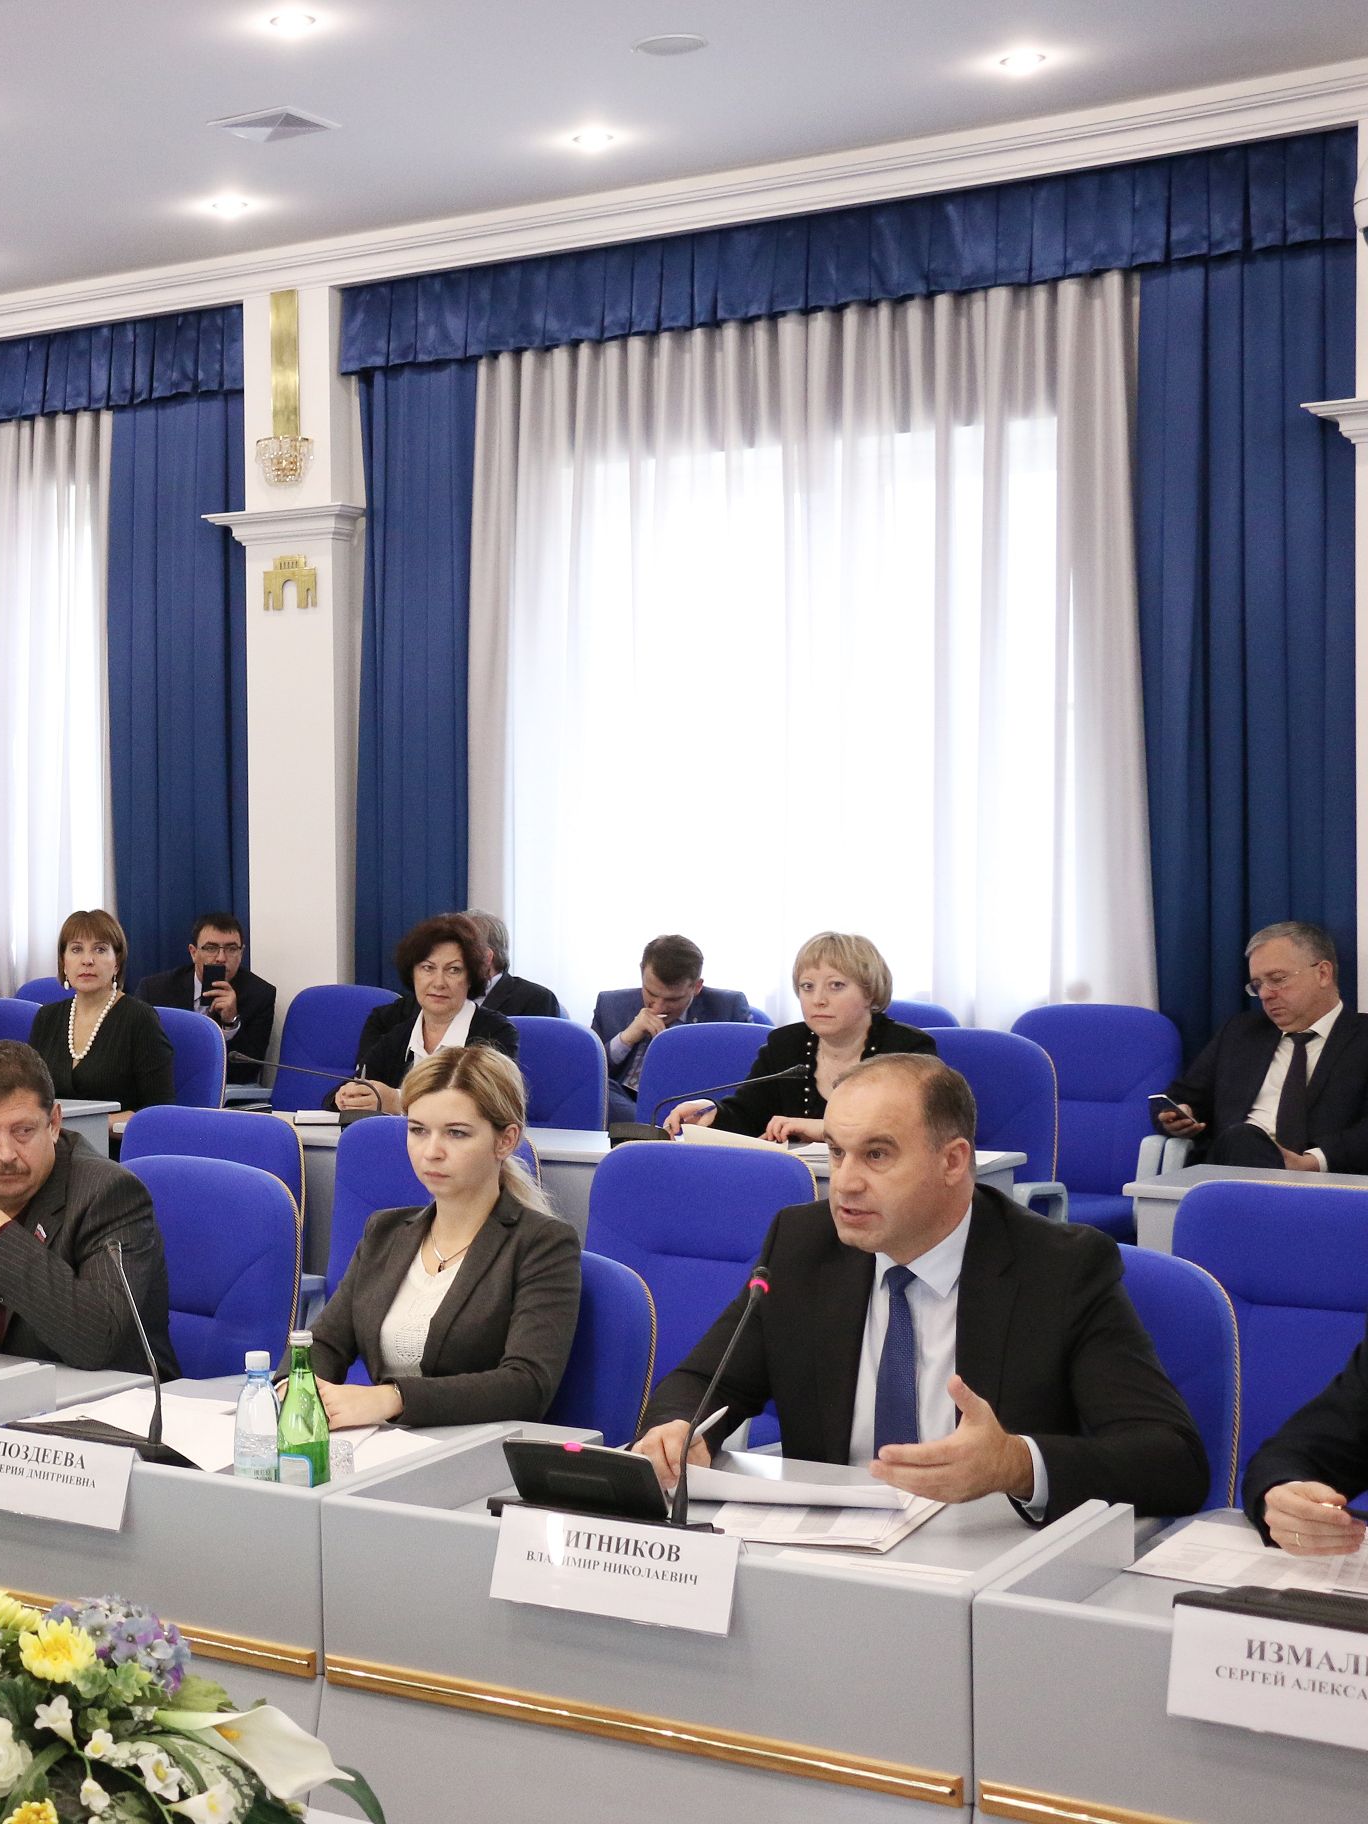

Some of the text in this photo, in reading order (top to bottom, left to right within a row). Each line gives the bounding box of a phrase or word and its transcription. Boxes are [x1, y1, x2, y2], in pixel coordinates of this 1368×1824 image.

[26, 1469, 96, 1489] ДМИТРИЕВНА
[549, 1526, 681, 1562] ИТНИКОВ
[526, 1550, 698, 1586] ВЛАИМИР НИКОЛАЕВИЧ
[1246, 1638, 1368, 1677] ИЗМАЛ
[1215, 1664, 1286, 1688] СЕРГЕЙ
